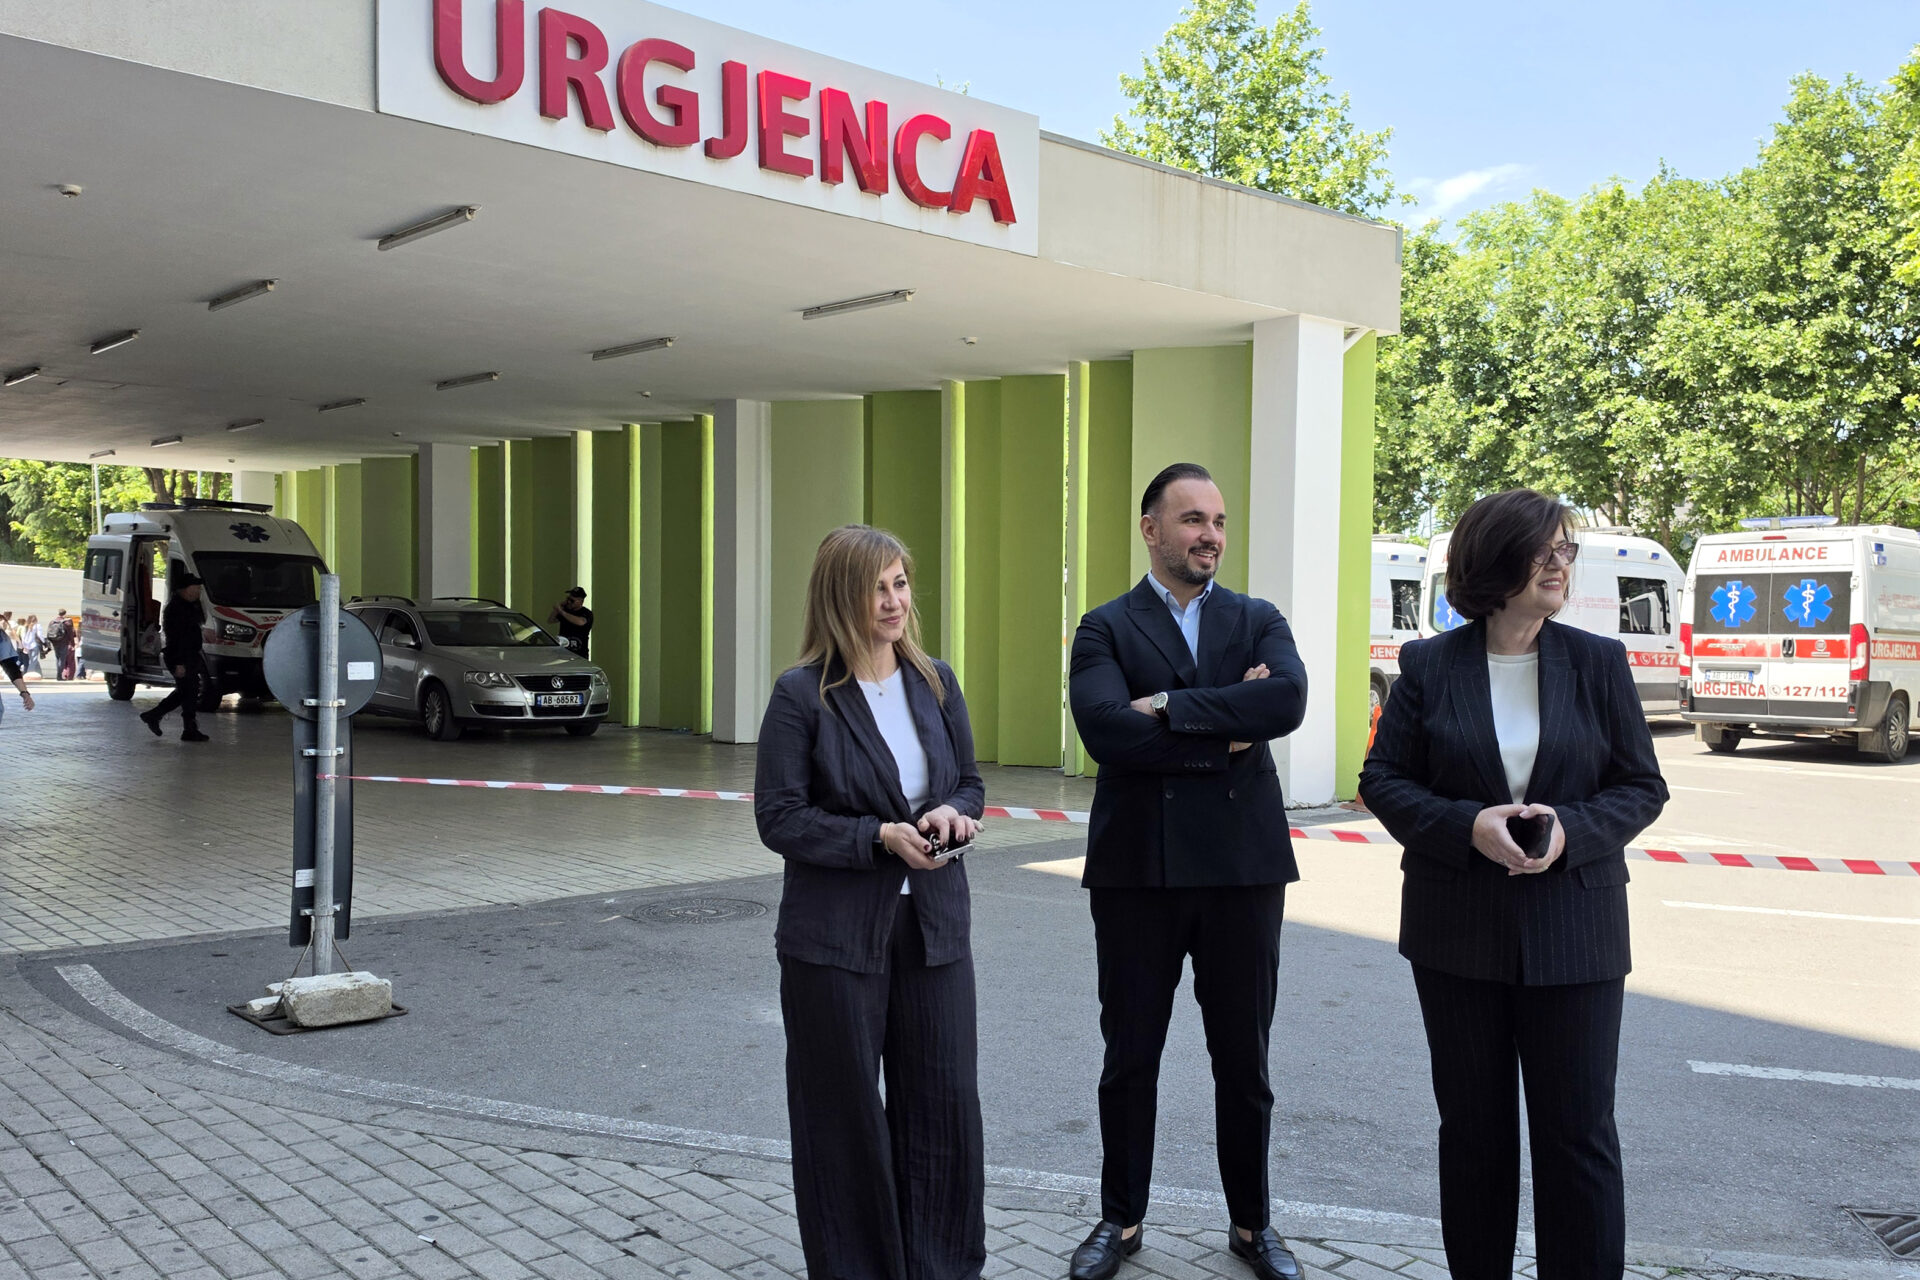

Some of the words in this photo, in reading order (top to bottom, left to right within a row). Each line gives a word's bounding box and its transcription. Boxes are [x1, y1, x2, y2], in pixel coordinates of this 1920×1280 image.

[432, 0, 1016, 226] URGJENCA
[1717, 546, 1829, 563] AMBULANCE
[1370, 646, 1400, 658] JENC
[1871, 642, 1917, 659] URGJENCA
[1694, 681, 1767, 697] URGJENCA
[543, 695, 553, 705] AB
